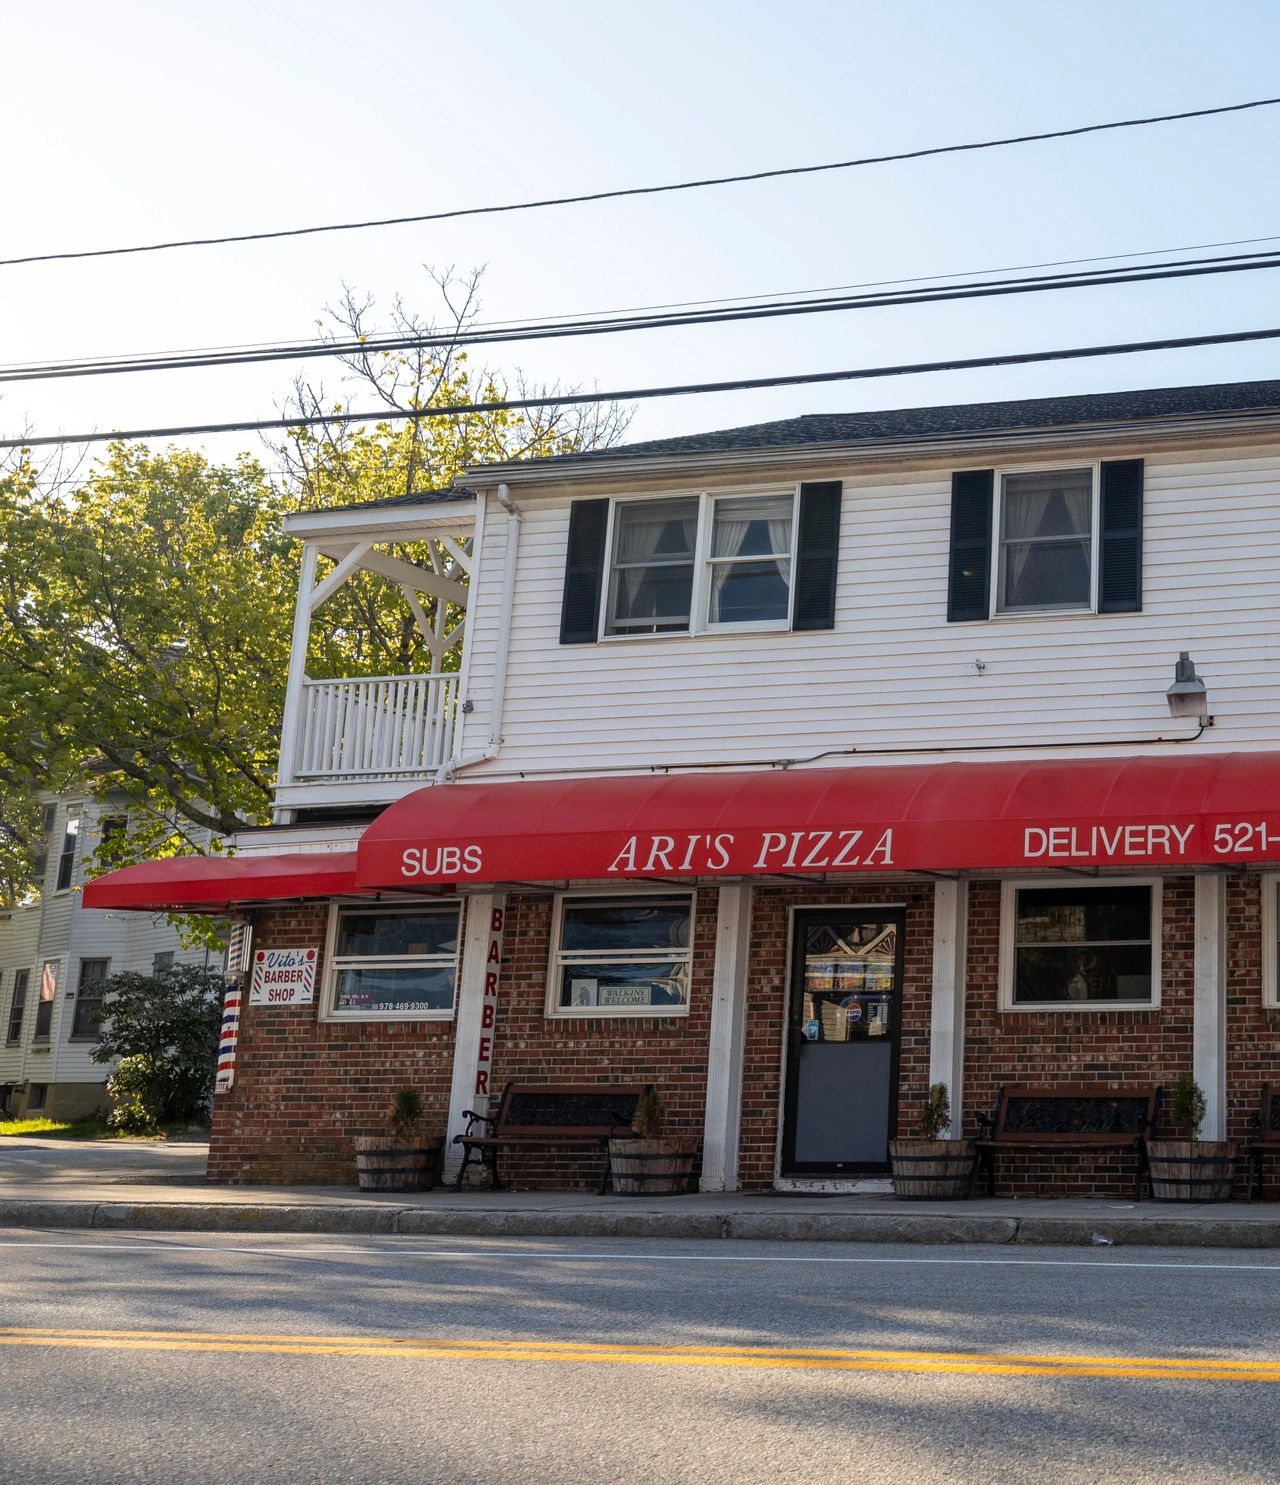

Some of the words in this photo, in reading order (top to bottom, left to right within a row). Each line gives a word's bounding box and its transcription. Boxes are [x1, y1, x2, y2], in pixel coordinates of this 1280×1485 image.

[607, 834, 734, 872] ARI'S
[753, 828, 895, 868] PIZZA
[1023, 824, 1195, 858] DELIVERY
[401, 846, 482, 877] SUBS
[266, 950, 306, 969] Vito's
[263, 969, 304, 984] BARBER
[268, 988, 295, 1002] SHOP
[475, 907, 504, 1095] BARBER
[604, 996, 646, 1004] WELCOME
